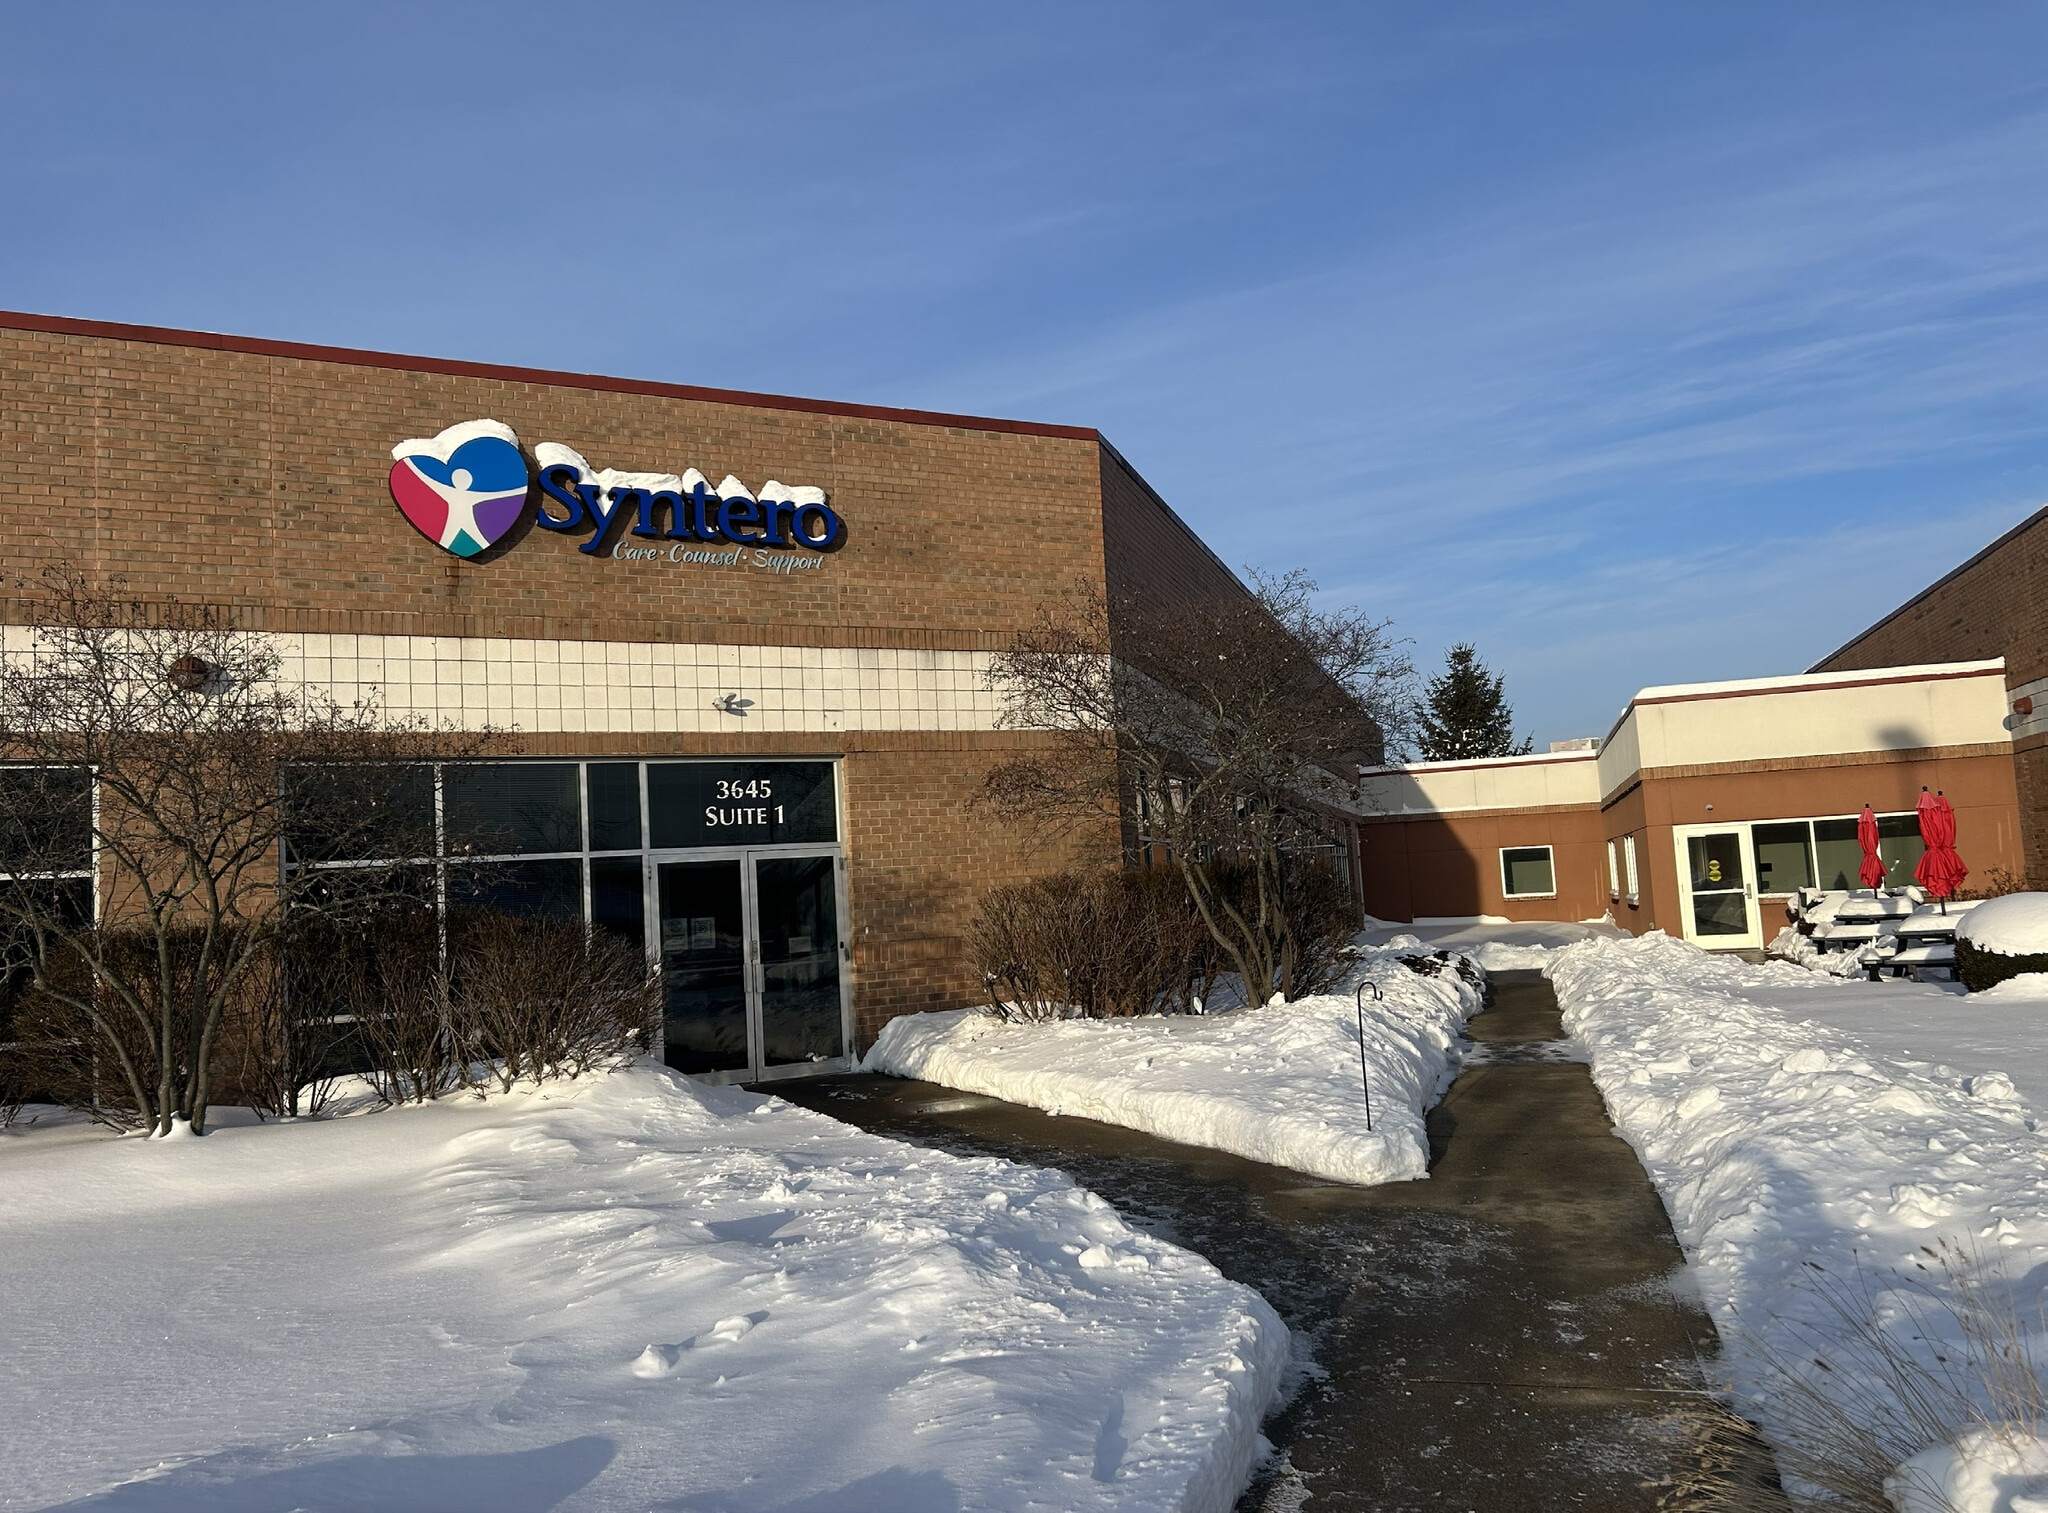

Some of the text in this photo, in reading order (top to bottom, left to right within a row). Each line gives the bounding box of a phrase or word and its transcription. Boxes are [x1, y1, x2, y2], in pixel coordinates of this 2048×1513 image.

[537, 465, 838, 552] Syntero
[613, 542, 823, 575] Care Counsel Support
[716, 780, 771, 799] 3645
[705, 804, 784, 826] SUITE 1
